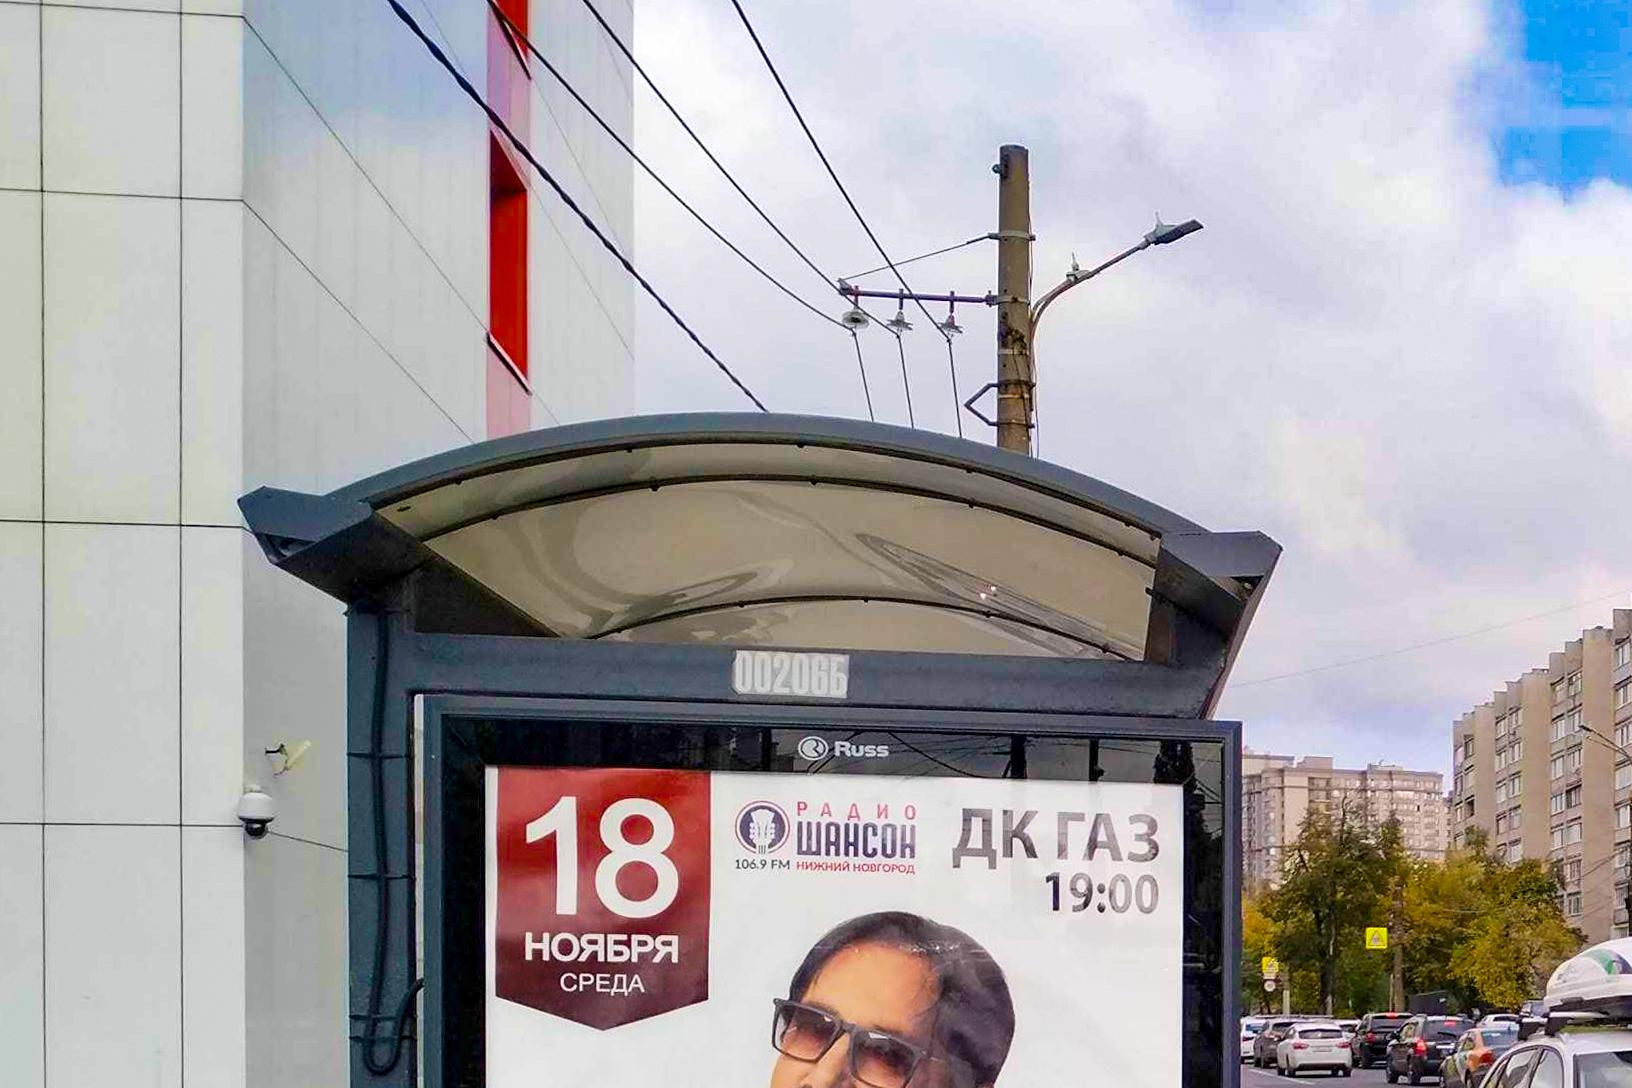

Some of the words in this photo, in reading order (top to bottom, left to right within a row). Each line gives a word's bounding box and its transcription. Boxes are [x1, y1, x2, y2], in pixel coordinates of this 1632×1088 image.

[735, 650, 848, 697] 002066
[835, 741, 889, 757] Russ
[797, 801, 916, 820] РАДИО
[797, 821, 916, 859] ШАНСОН
[952, 808, 1038, 869] ДК
[1056, 812, 1160, 862] ГАЗ
[526, 796, 679, 918] 18
[735, 859, 767, 870] 106.9
[770, 859, 790, 870] FM
[796, 861, 850, 872] НИЖНИЙ
[853, 863, 915, 874] НОВГОРОД
[1045, 872, 1159, 914] 19:00
[525, 932, 679, 963] НОЯБРЯ
[560, 973, 645, 996] СРЕДА
